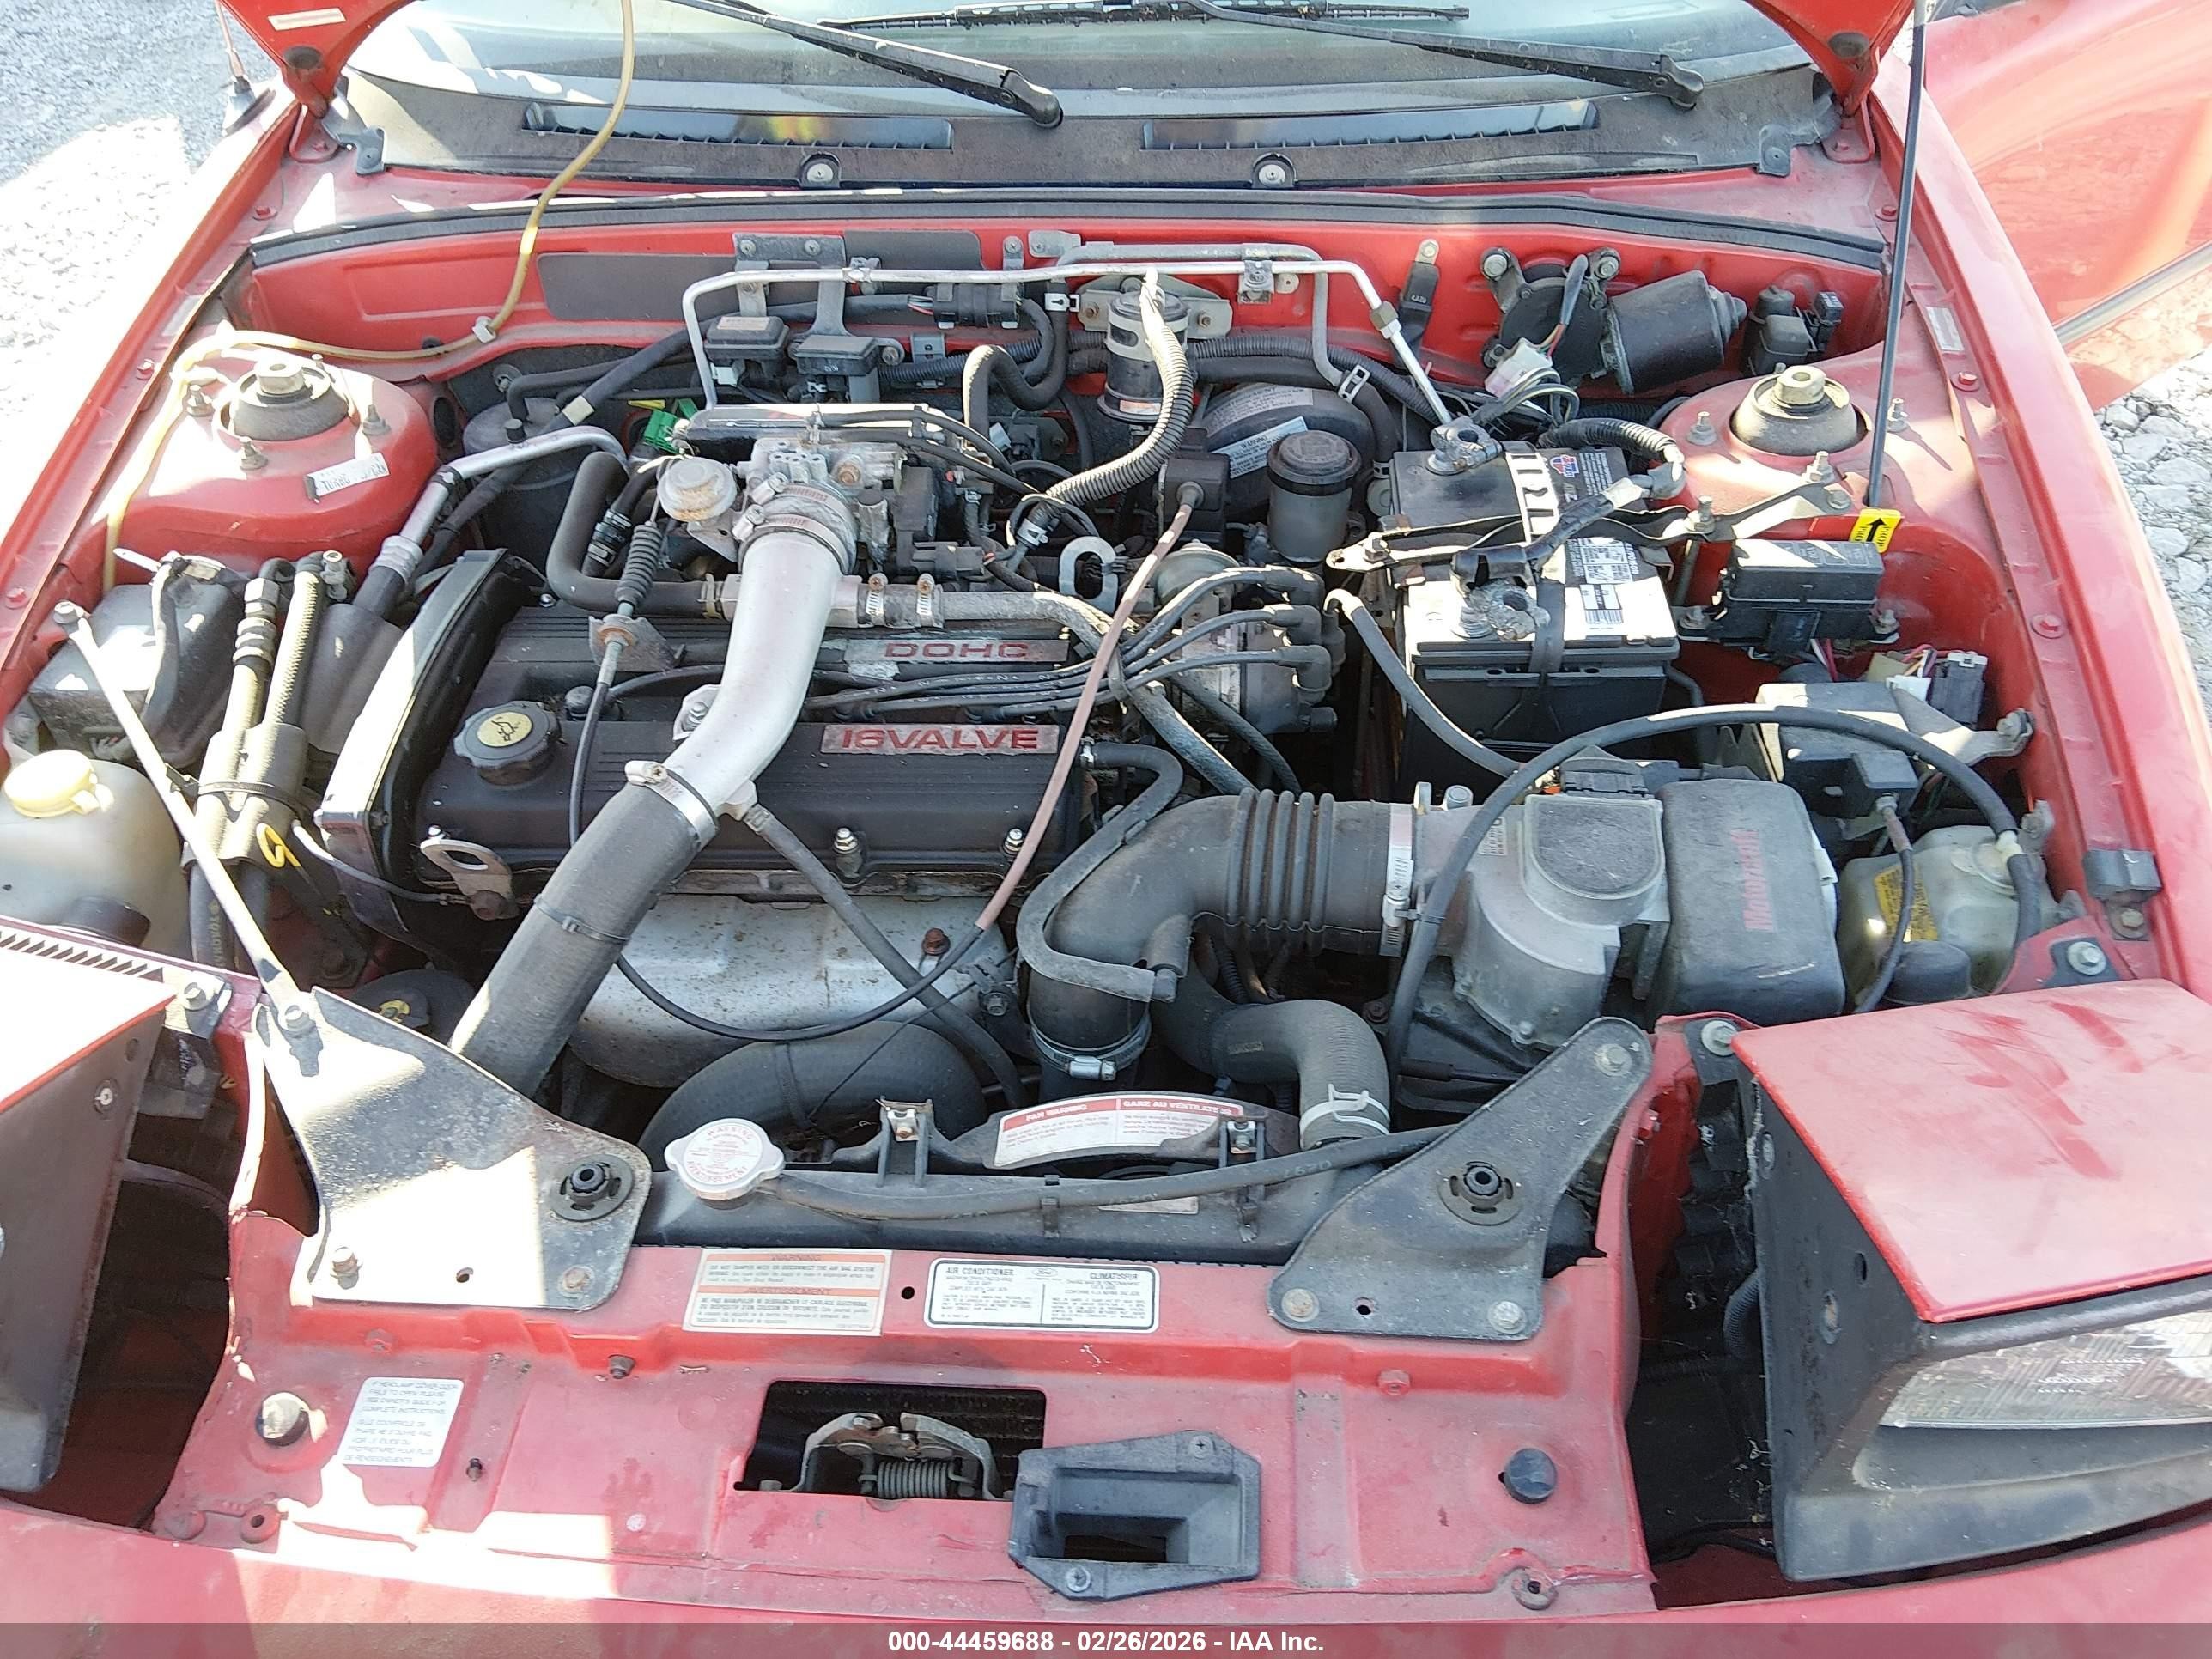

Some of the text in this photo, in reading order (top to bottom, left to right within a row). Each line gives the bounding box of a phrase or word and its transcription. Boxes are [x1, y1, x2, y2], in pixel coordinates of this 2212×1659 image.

[884, 642, 1030, 659] DOHC
[1025, 1103, 1088, 1121] FAN WARNING
[771, 1253, 822, 1261] WARNING
[962, 1267, 1015, 1276] CONDITIONER
[744, 1287, 831, 1296] AVERTISSEMENT
